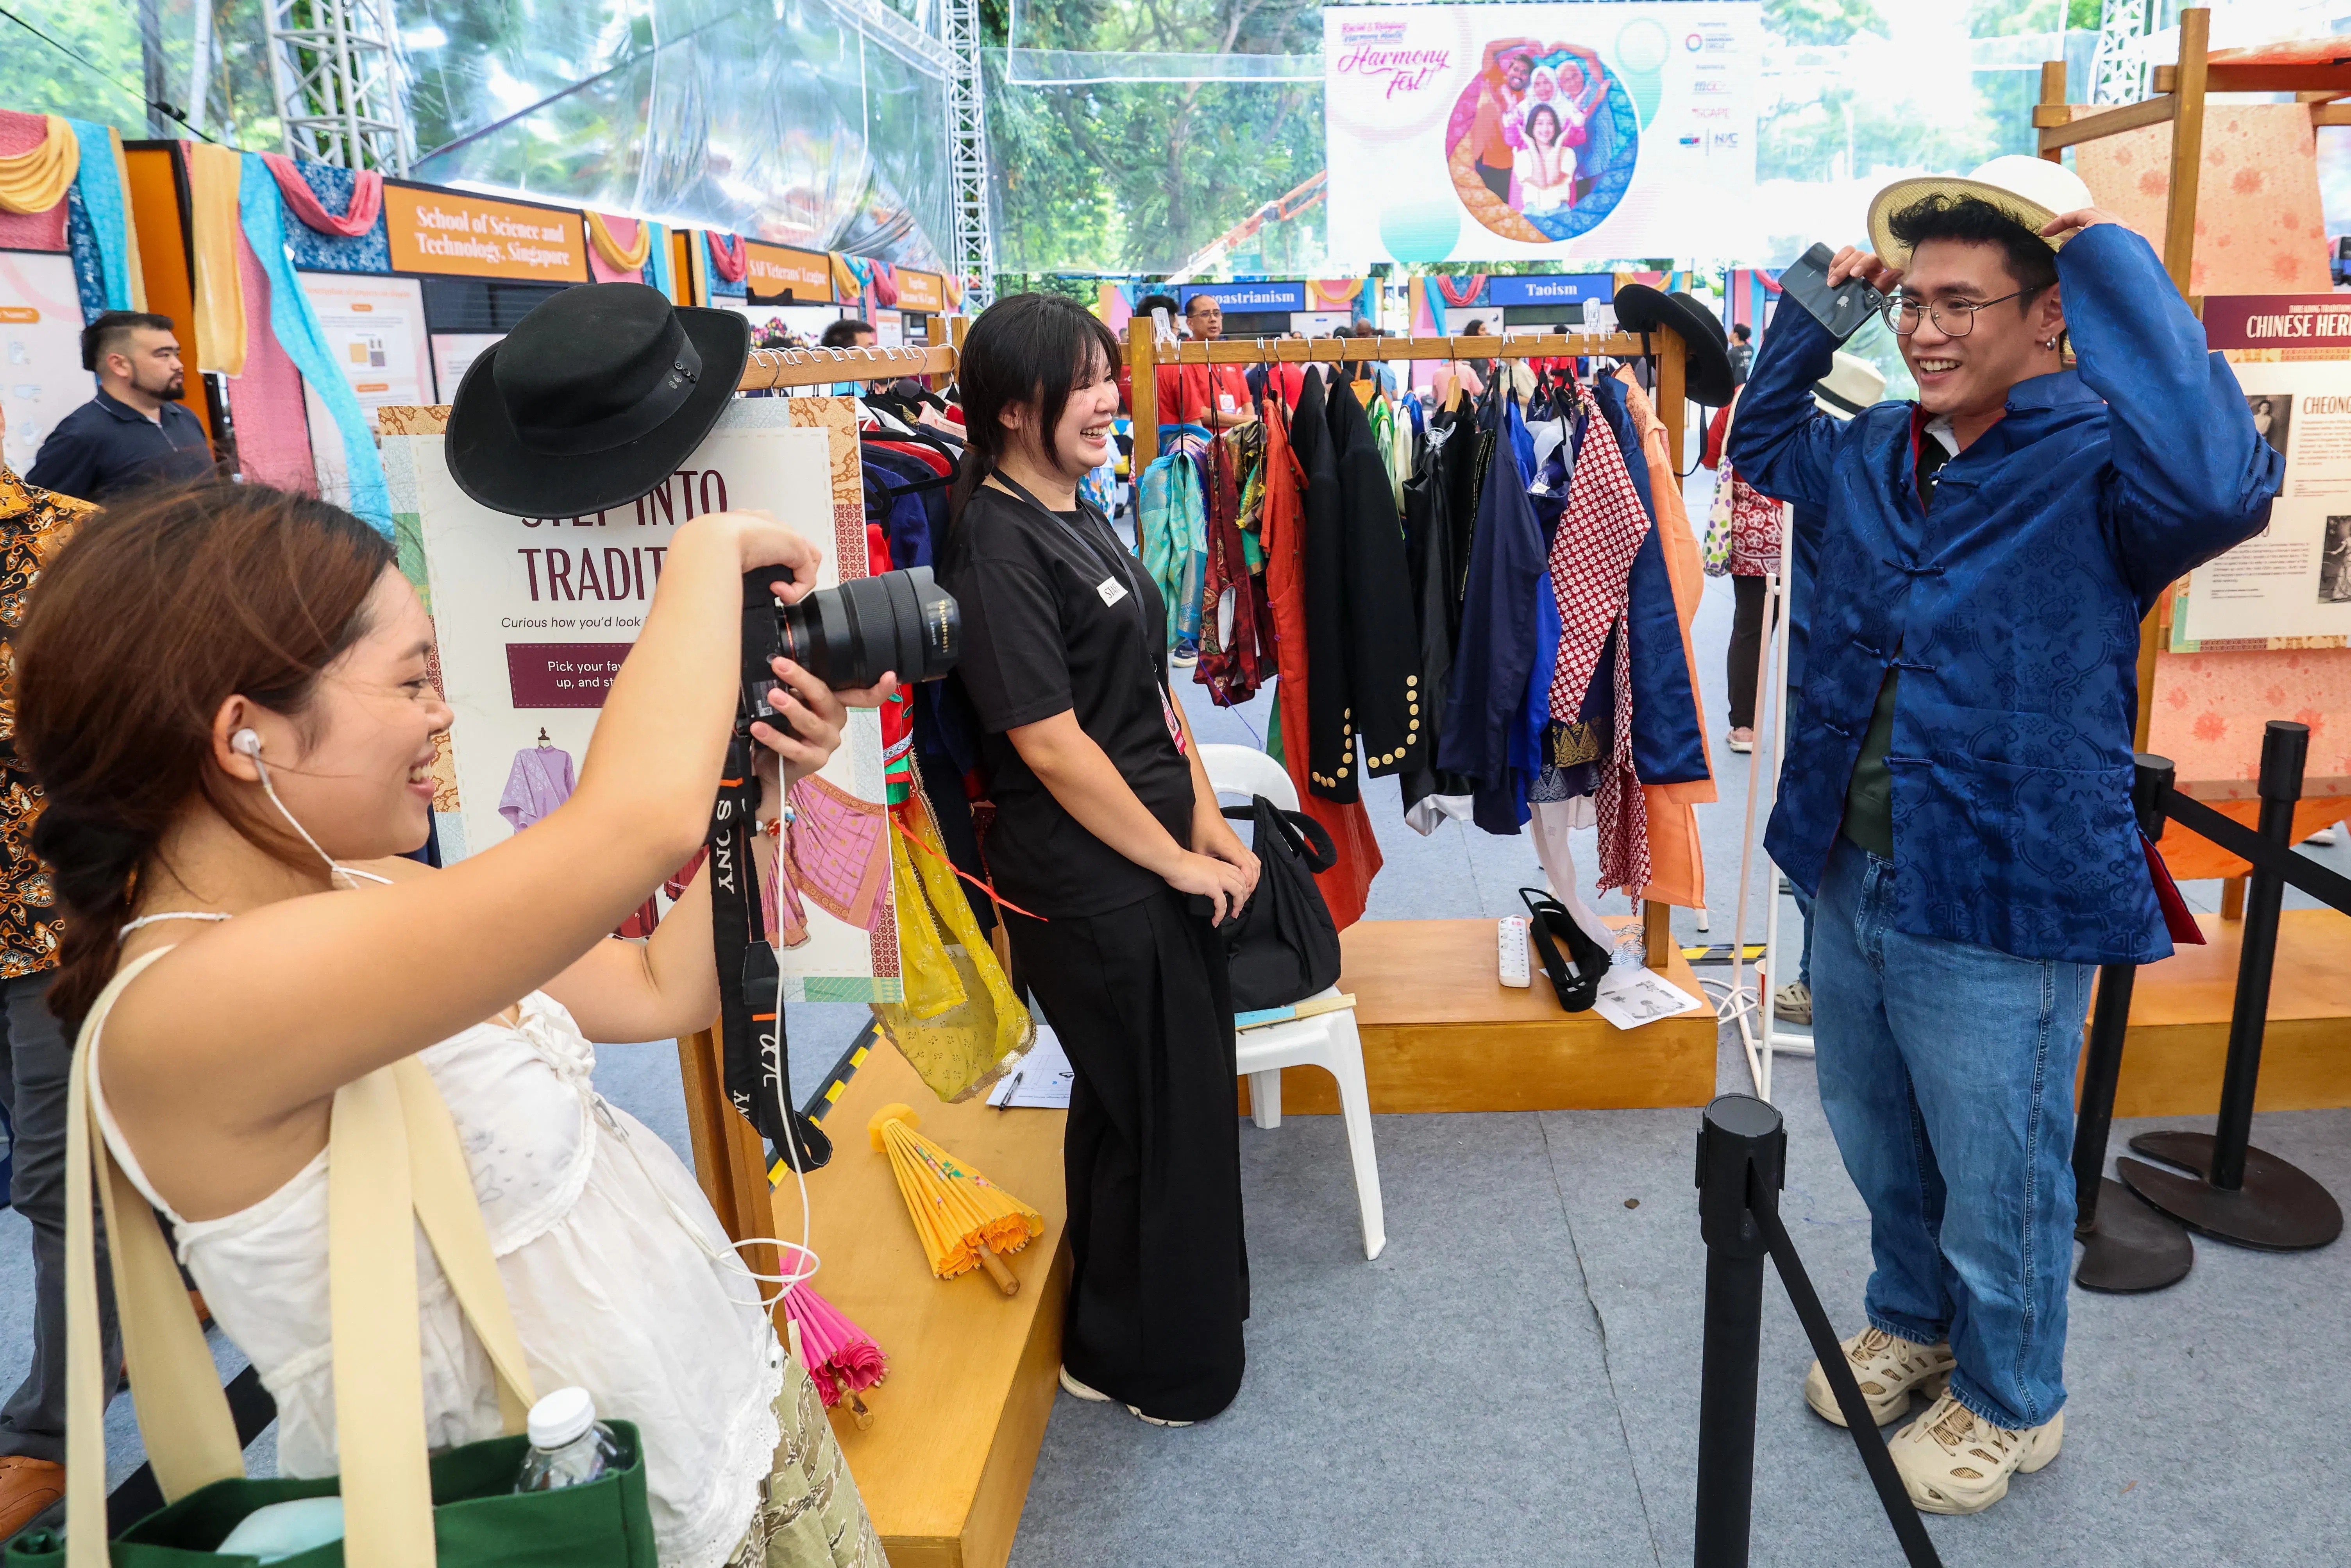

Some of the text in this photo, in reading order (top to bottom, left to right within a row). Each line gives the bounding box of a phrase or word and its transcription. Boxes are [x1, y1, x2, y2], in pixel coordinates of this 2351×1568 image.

[1338, 44, 1451, 75] Harmony
[416, 206, 565, 243] School of Science and
[414, 232, 570, 268] Technology, Singapore
[749, 259, 765, 277] SAF
[802, 267, 827, 287] League
[1191, 290, 1295, 304] oastrianism
[1525, 282, 1577, 297] Taoism
[2246, 314, 2314, 338] CHINESE
[1104, 583, 1120, 599] STAFF
[501, 617, 547, 628] Curious
[551, 617, 576, 628] how
[616, 616, 641, 627] look
[548, 661, 573, 672] Pick
[577, 662, 603, 674] your
[556, 678, 574, 689] up,
[578, 677, 599, 687] and
